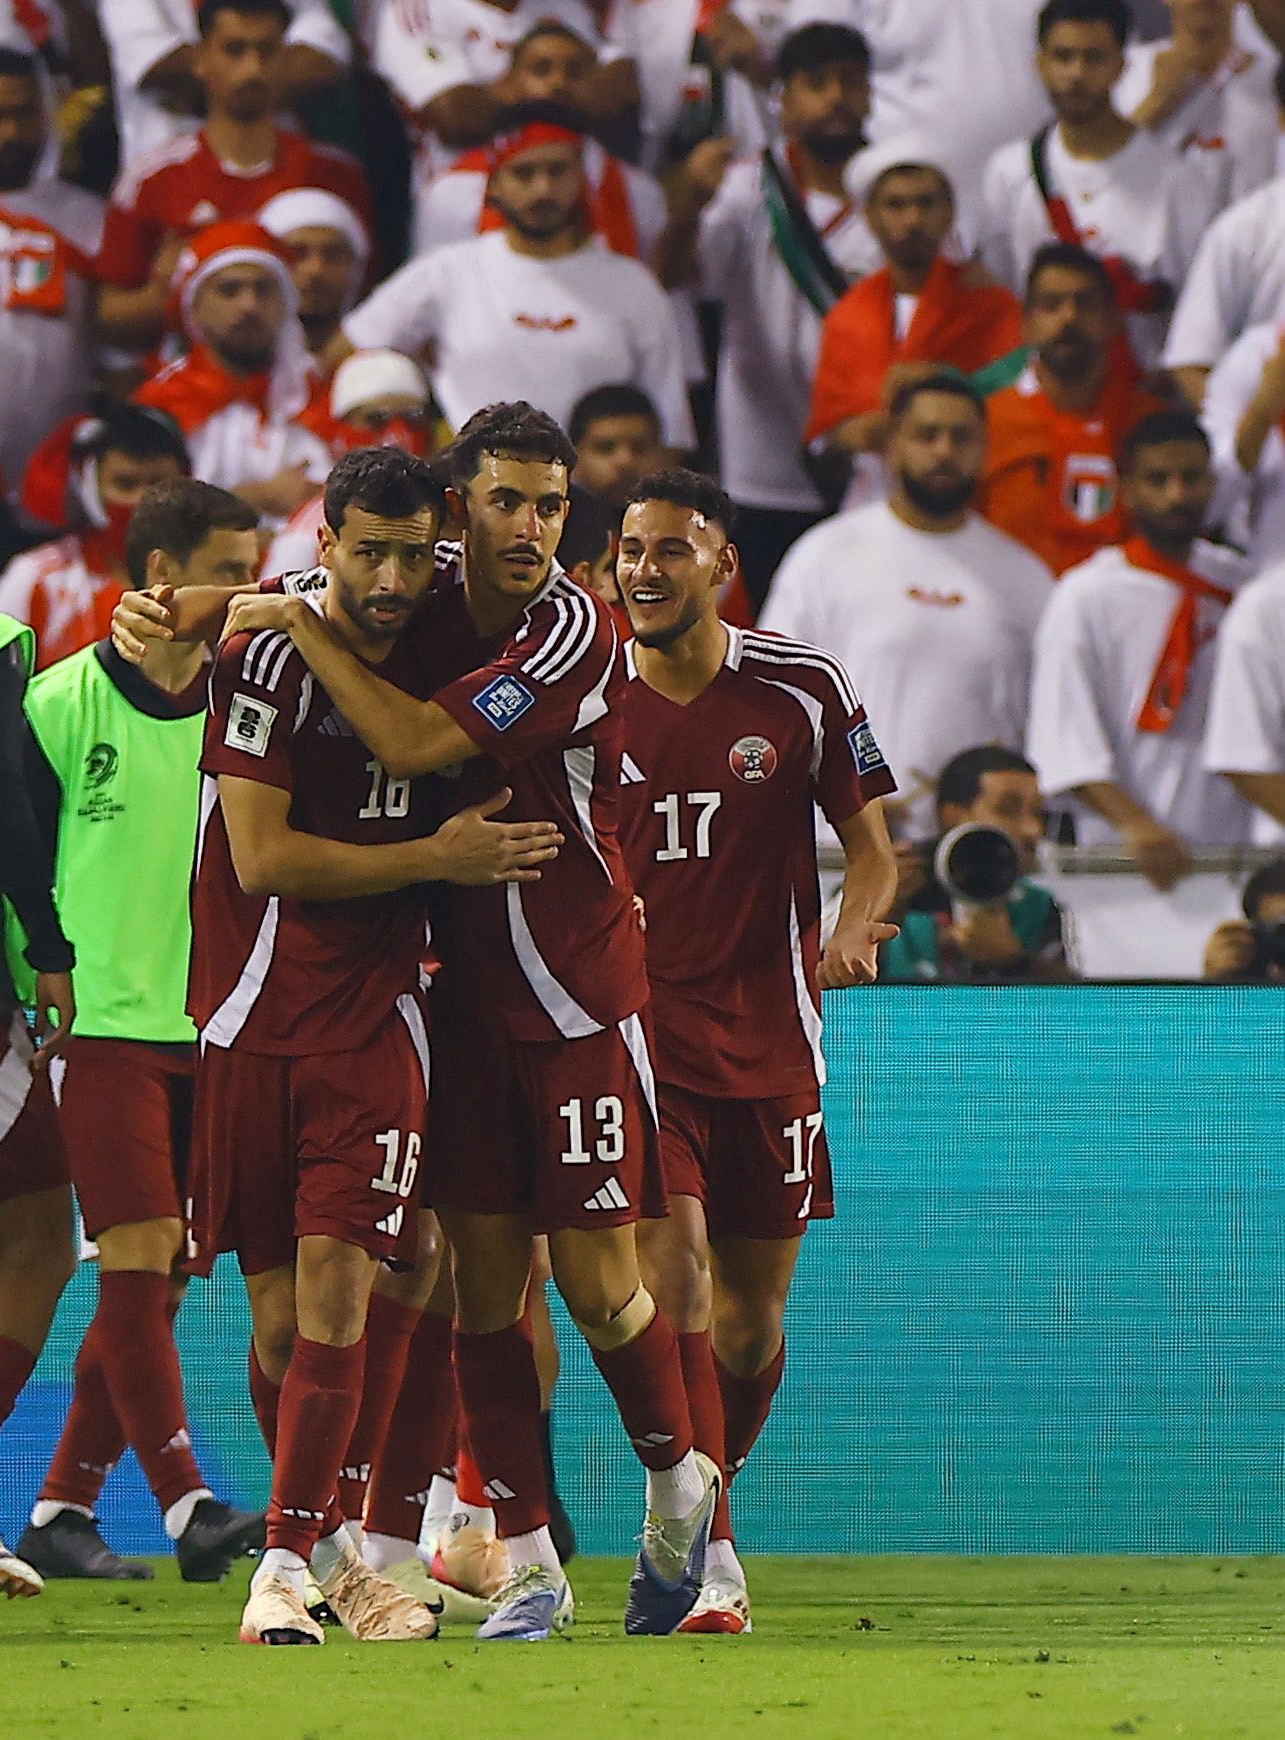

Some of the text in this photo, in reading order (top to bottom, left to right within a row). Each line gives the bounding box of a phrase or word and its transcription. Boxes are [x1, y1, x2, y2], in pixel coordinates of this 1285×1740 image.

[654, 791, 722, 861] 17
[370, 1129, 422, 1198] 16
[559, 1095, 625, 1165] 13
[782, 1110, 823, 1184] 17
